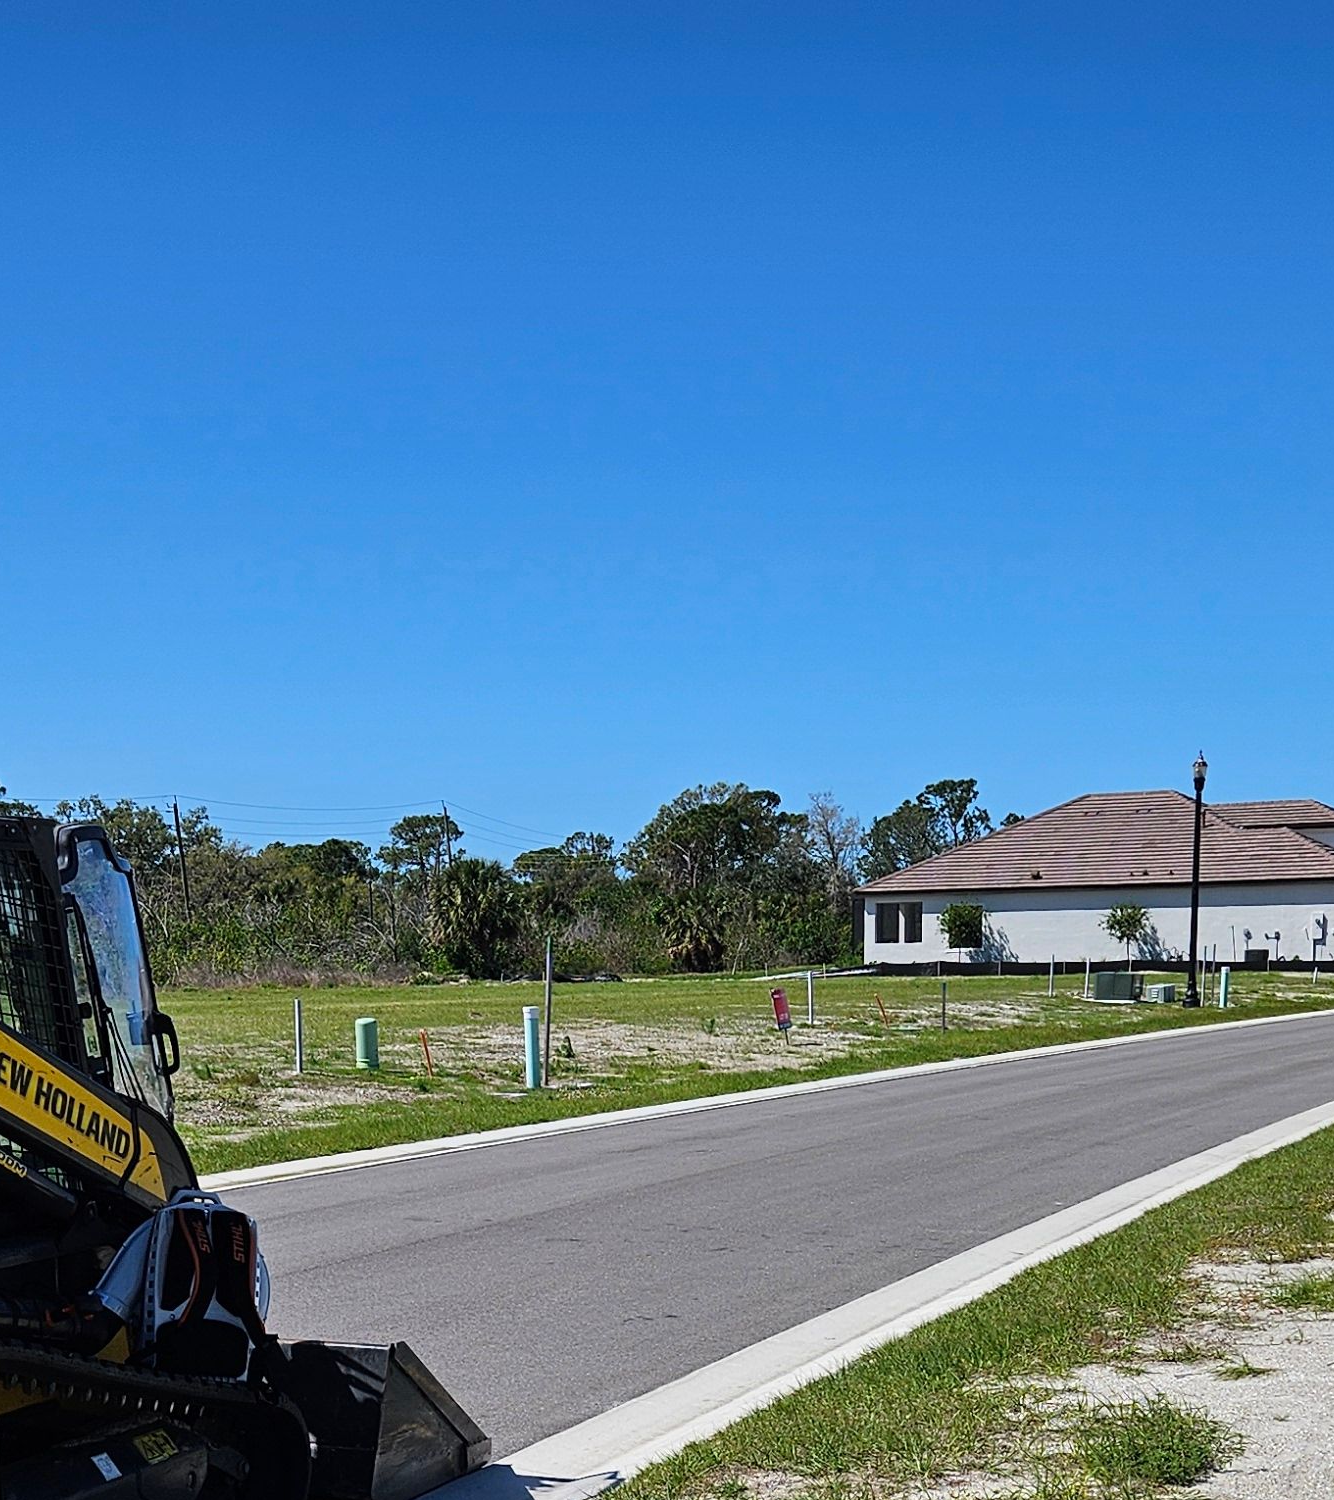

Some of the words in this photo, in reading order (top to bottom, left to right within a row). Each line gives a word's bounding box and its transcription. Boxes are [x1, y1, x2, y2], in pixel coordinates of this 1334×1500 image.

[34, 1074, 131, 1160] HOLLAND
[191, 1220, 211, 1254] STIHL
[229, 1221, 245, 1264] STIHL
